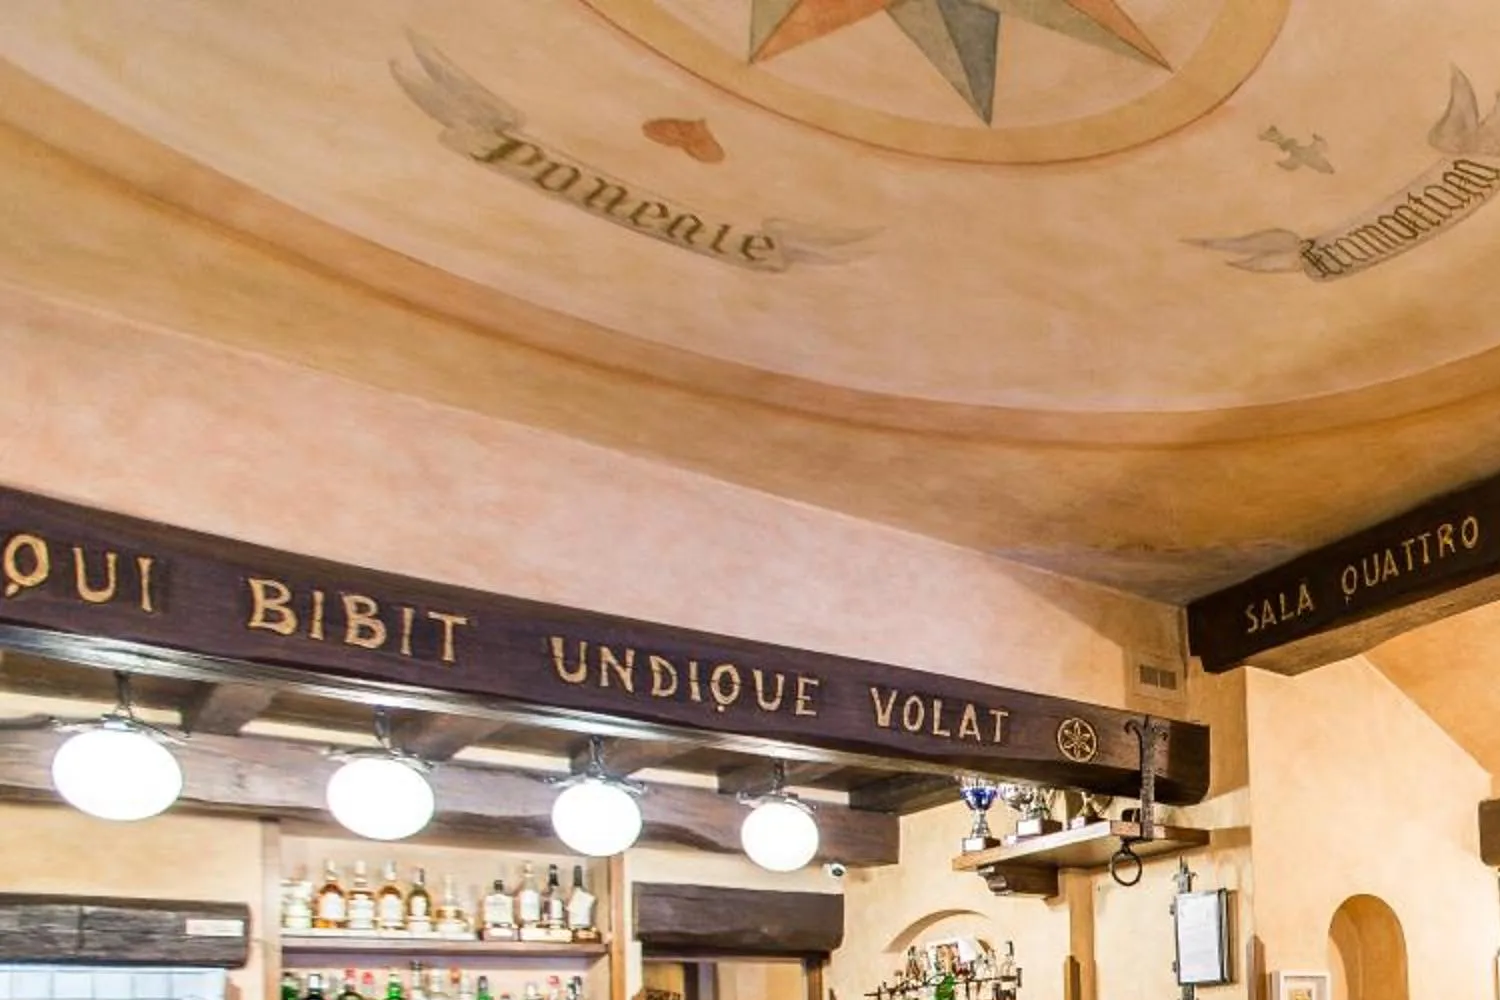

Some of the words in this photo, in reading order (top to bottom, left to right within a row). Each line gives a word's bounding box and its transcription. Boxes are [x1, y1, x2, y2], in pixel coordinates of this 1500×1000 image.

[2, 533, 155, 613] QUI
[248, 577, 470, 663] BIBIT
[550, 636, 820, 717] UNDIQUE
[869, 686, 1011, 744] VOLAT
[1244, 583, 1314, 634] SALA
[1341, 515, 1480, 605] QUATTRO
